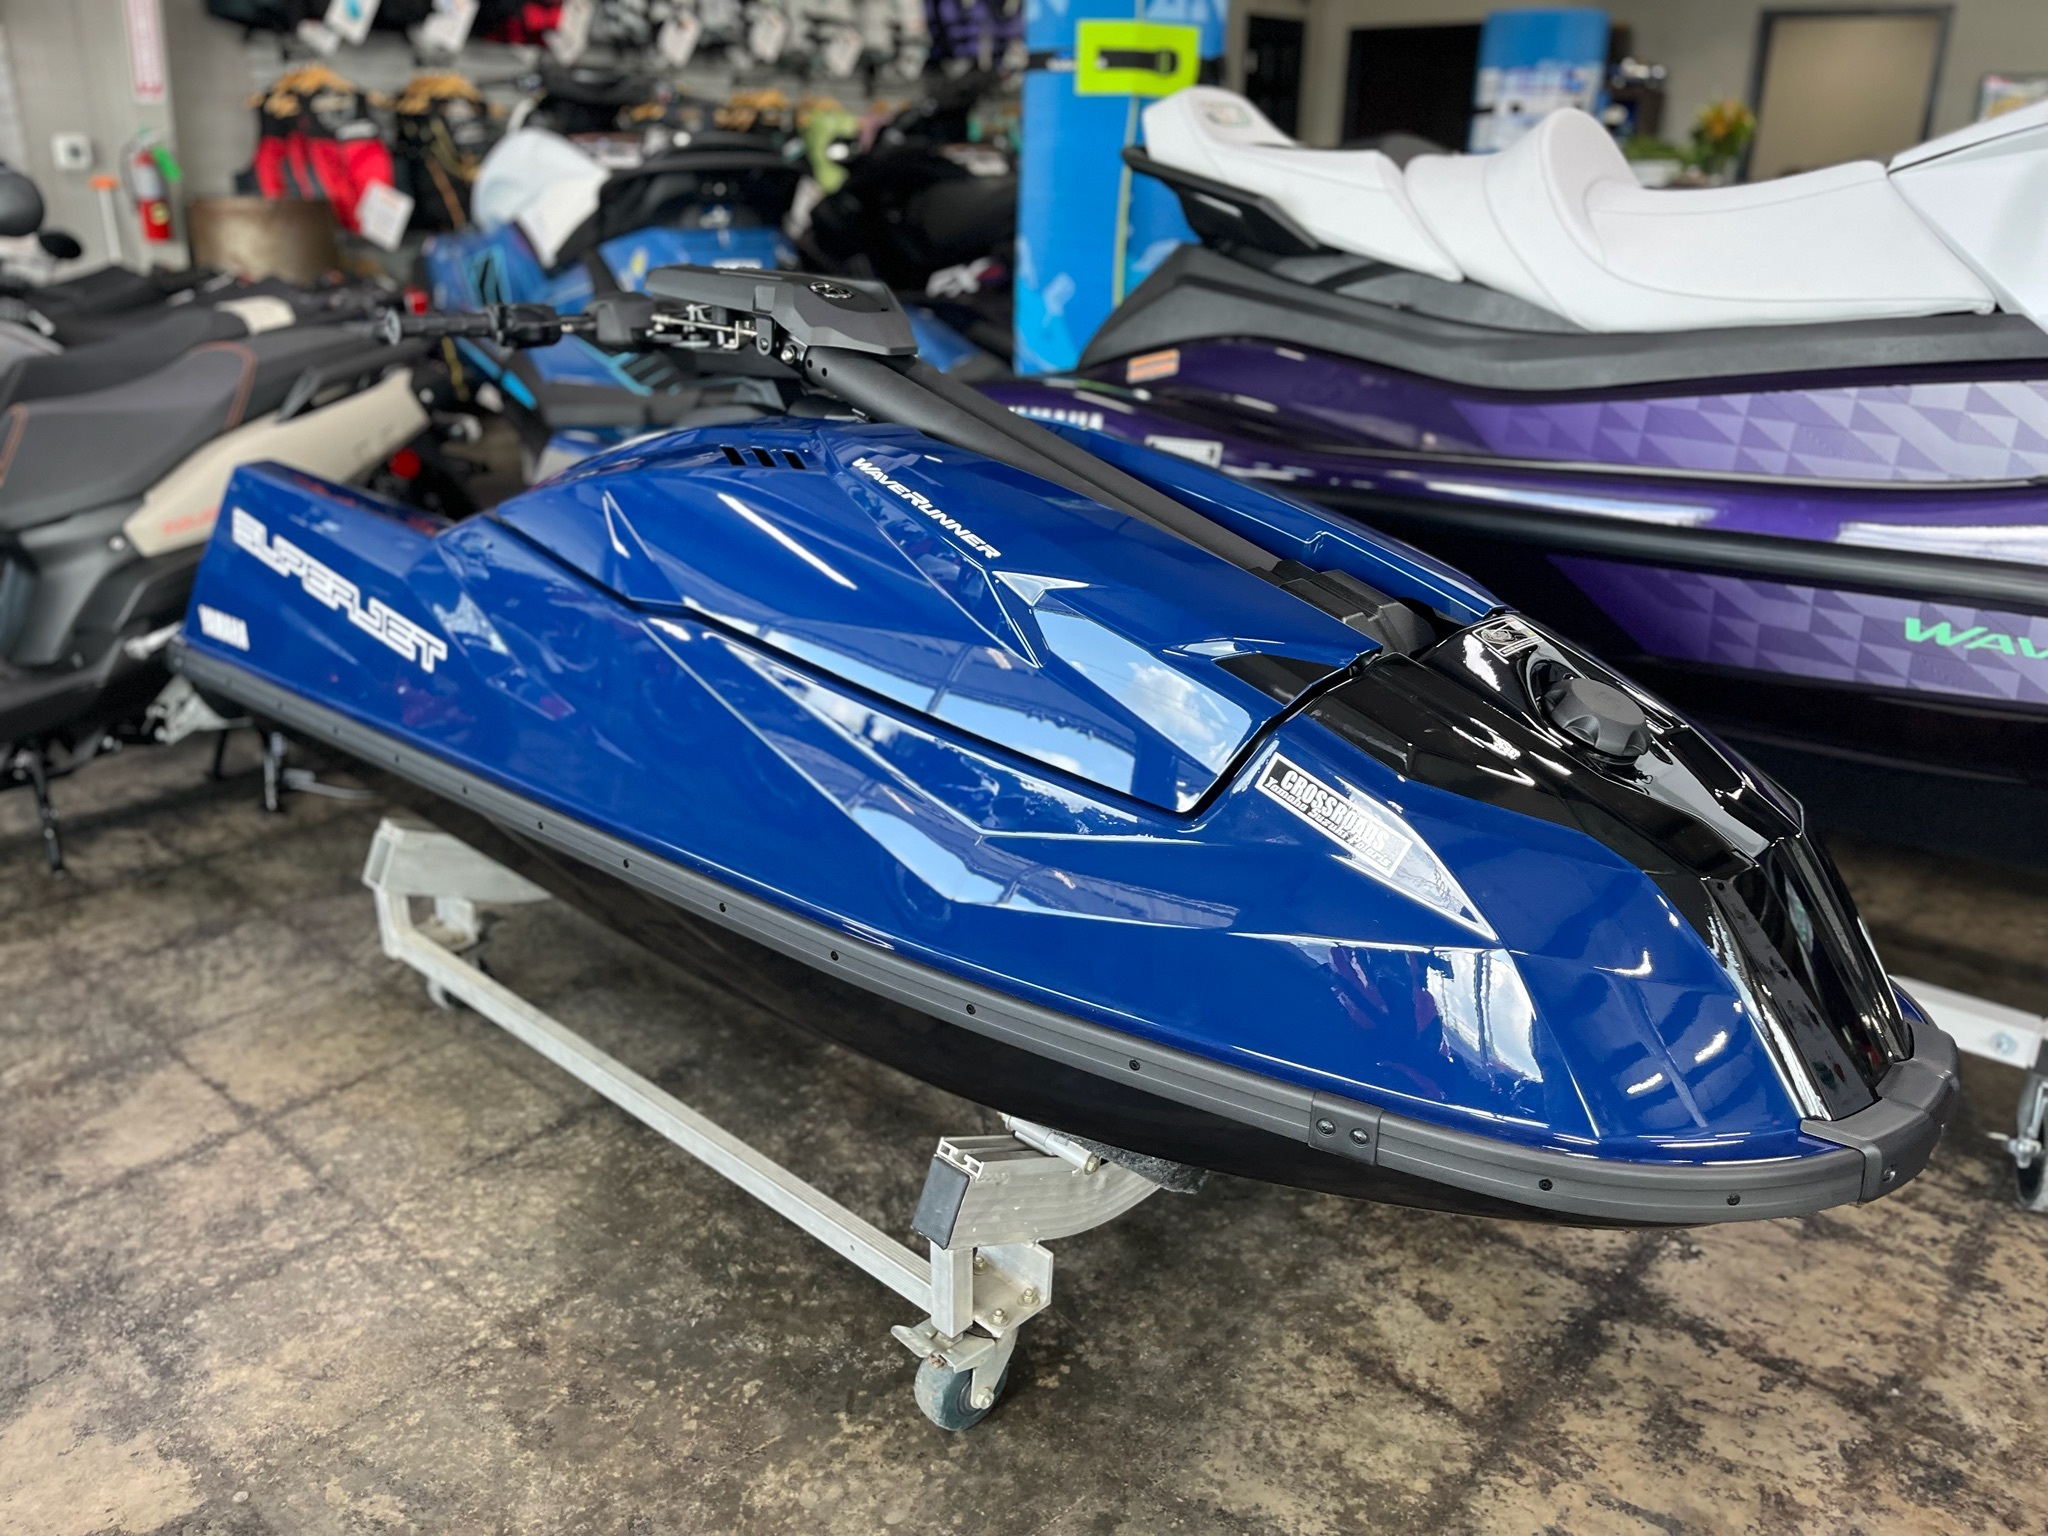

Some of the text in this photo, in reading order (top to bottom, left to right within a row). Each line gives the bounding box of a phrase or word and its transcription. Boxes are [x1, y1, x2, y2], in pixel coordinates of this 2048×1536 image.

[852, 457, 1002, 559] WAVERUNNER
[1264, 776, 1393, 868] Yamaha Suzuki Polaris
[1280, 769, 1390, 852] CROSSROADS
